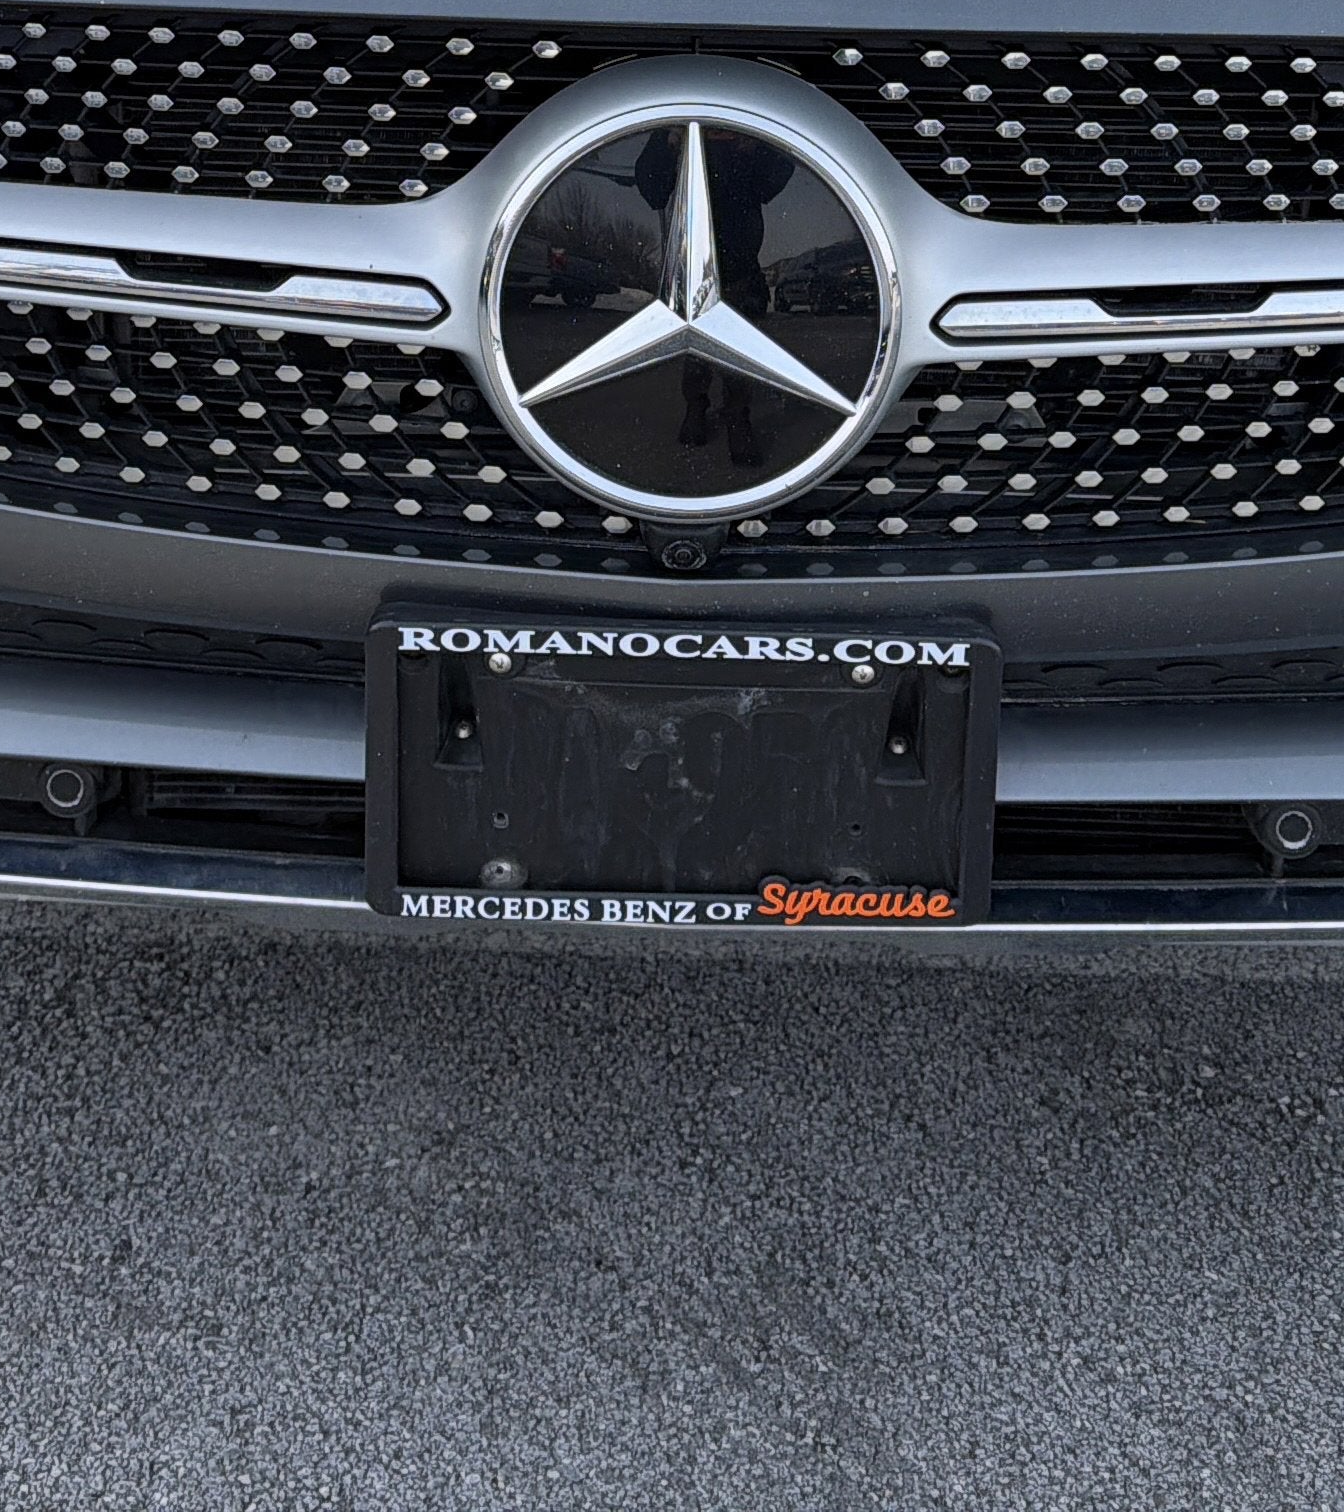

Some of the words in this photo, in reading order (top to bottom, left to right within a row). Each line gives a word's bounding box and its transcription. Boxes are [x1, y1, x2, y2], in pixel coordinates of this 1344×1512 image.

[397, 626, 971, 667] ROMANOCARS.COM
[399, 893, 591, 921] MERCEDES
[600, 898, 697, 923] BENZ
[705, 902, 752, 921] OF
[757, 882, 956, 926] Syracuse
